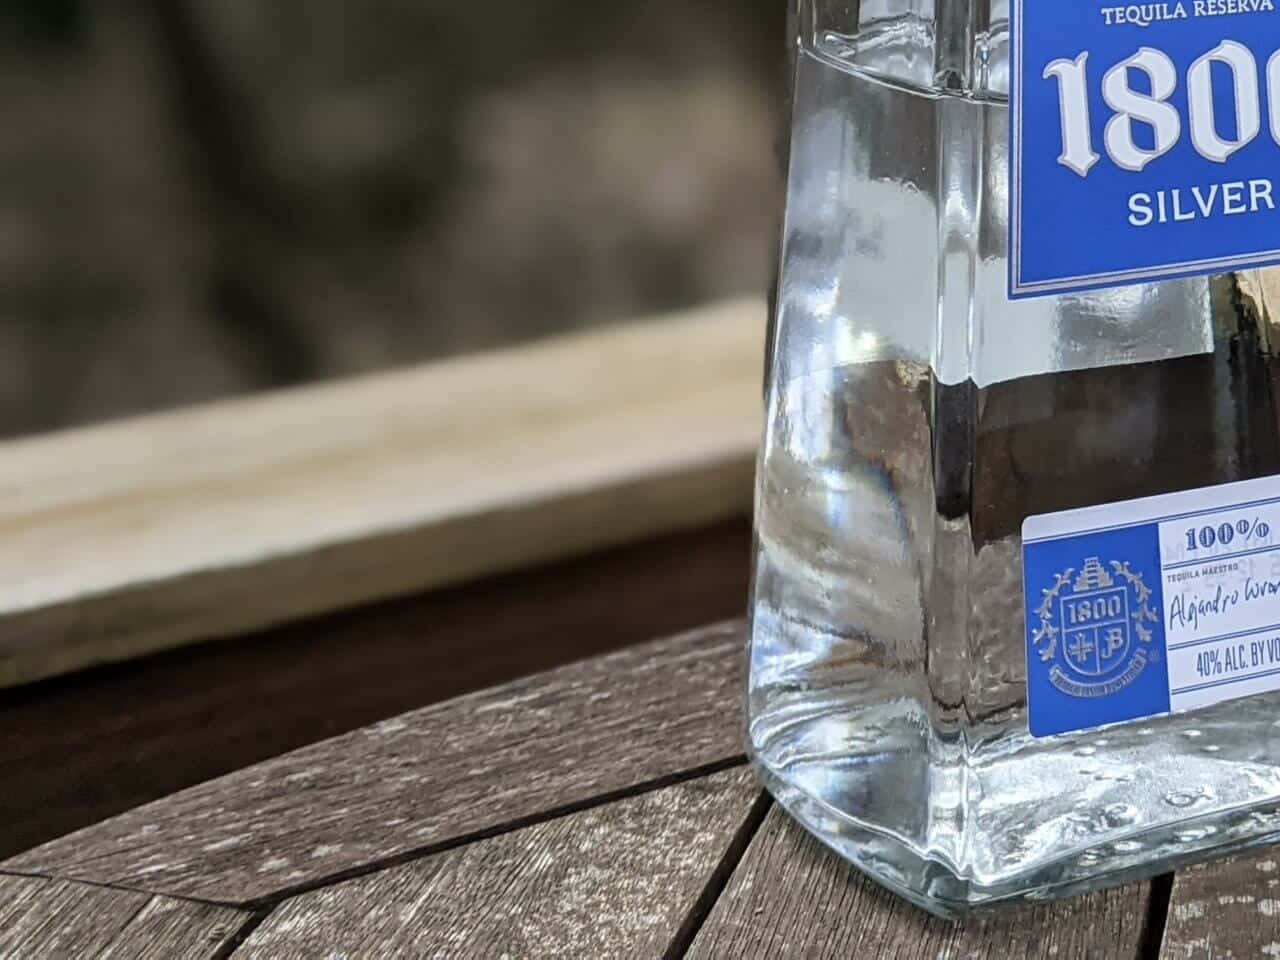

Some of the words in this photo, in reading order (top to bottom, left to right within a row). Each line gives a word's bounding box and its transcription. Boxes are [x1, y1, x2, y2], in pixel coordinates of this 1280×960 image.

[1101, 1, 1188, 27] TEQUILA
[1127, 179, 1276, 227] SILVER
[1185, 517, 1270, 551] 100%
[1167, 570, 1200, 583] TEQUILA
[1201, 563, 1239, 577] MAESTRO
[1068, 595, 1121, 624] 1800
[1196, 648, 1223, 678] 40%
[1224, 642, 1249, 673] ALC.
[1251, 638, 1267, 668] BY
